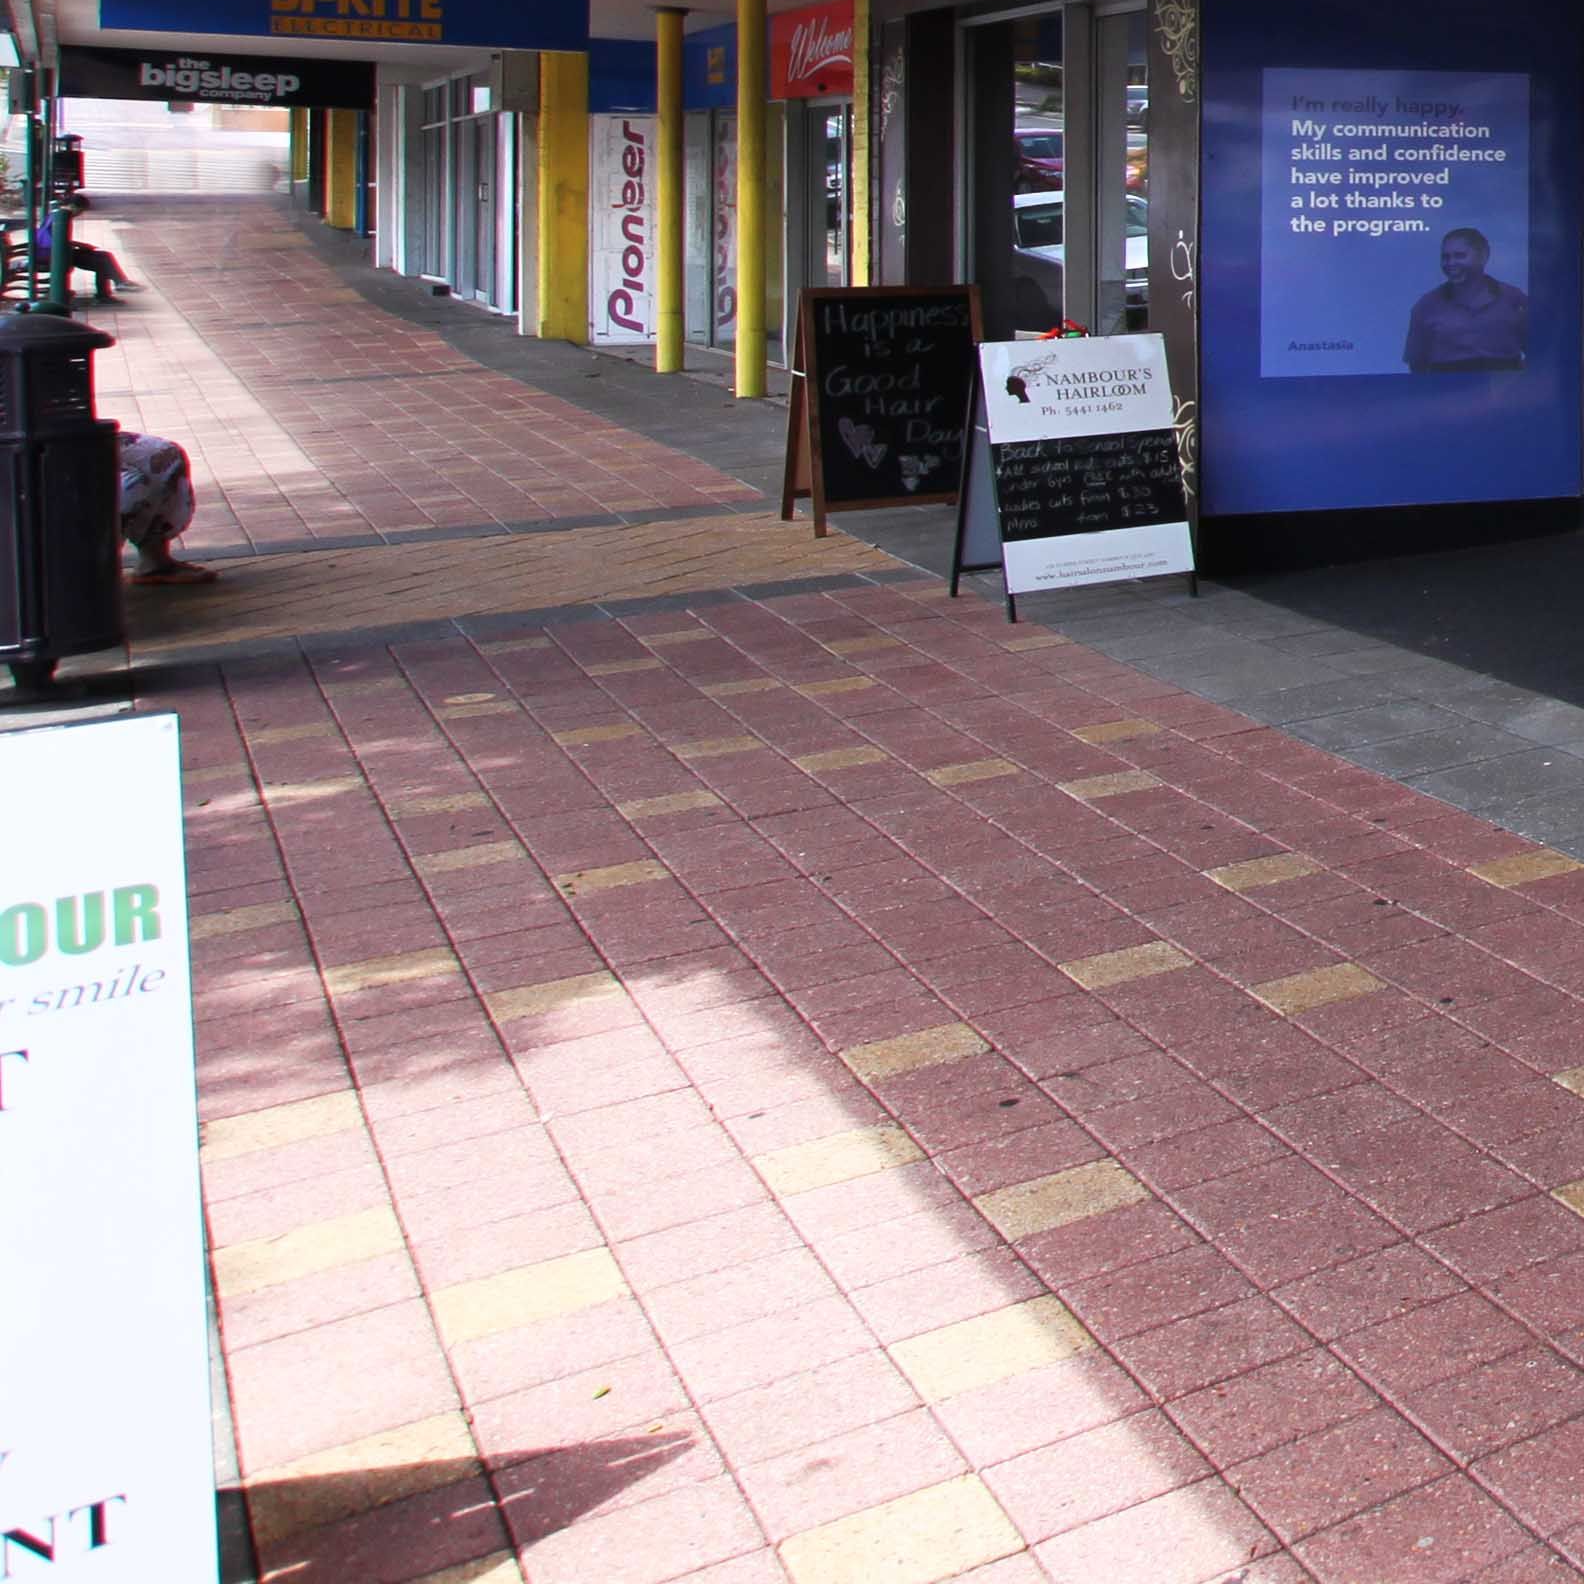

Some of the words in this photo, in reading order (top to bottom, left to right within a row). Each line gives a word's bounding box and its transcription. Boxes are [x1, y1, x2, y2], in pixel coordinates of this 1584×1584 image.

[273, 18, 441, 39] ELECTRICAL
[178, 57, 210, 70] the
[140, 63, 300, 96] bigsleep
[200, 88, 273, 101] company
[1292, 96, 1324, 113] I'm
[1331, 96, 1388, 117] really
[1396, 97, 1464, 117] happy.
[1291, 120, 1326, 140] My
[1333, 121, 1490, 138] communication
[1291, 143, 1342, 160] skills
[1348, 144, 1387, 160] and
[1394, 144, 1506, 162] confidence
[1291, 167, 1342, 184] have
[1348, 168, 1449, 188] improved
[1290, 196, 1303, 208] a
[1310, 191, 1339, 208] lot
[1346, 192, 1415, 208] thanks
[1420, 193, 1443, 208] to
[1291, 215, 1326, 232] the
[1333, 218, 1430, 236] program.
[864, 338, 891, 357] is
[906, 337, 935, 352] a
[825, 364, 920, 396] Good
[1046, 368, 1152, 386] NAMBOUR'S
[1057, 383, 1147, 401] HAIRLOOM
[865, 395, 945, 415] Hair
[1065, 404, 1092, 416] 5441
[1096, 402, 1123, 414] 1462
[27, 964, 166, 1016] smile
